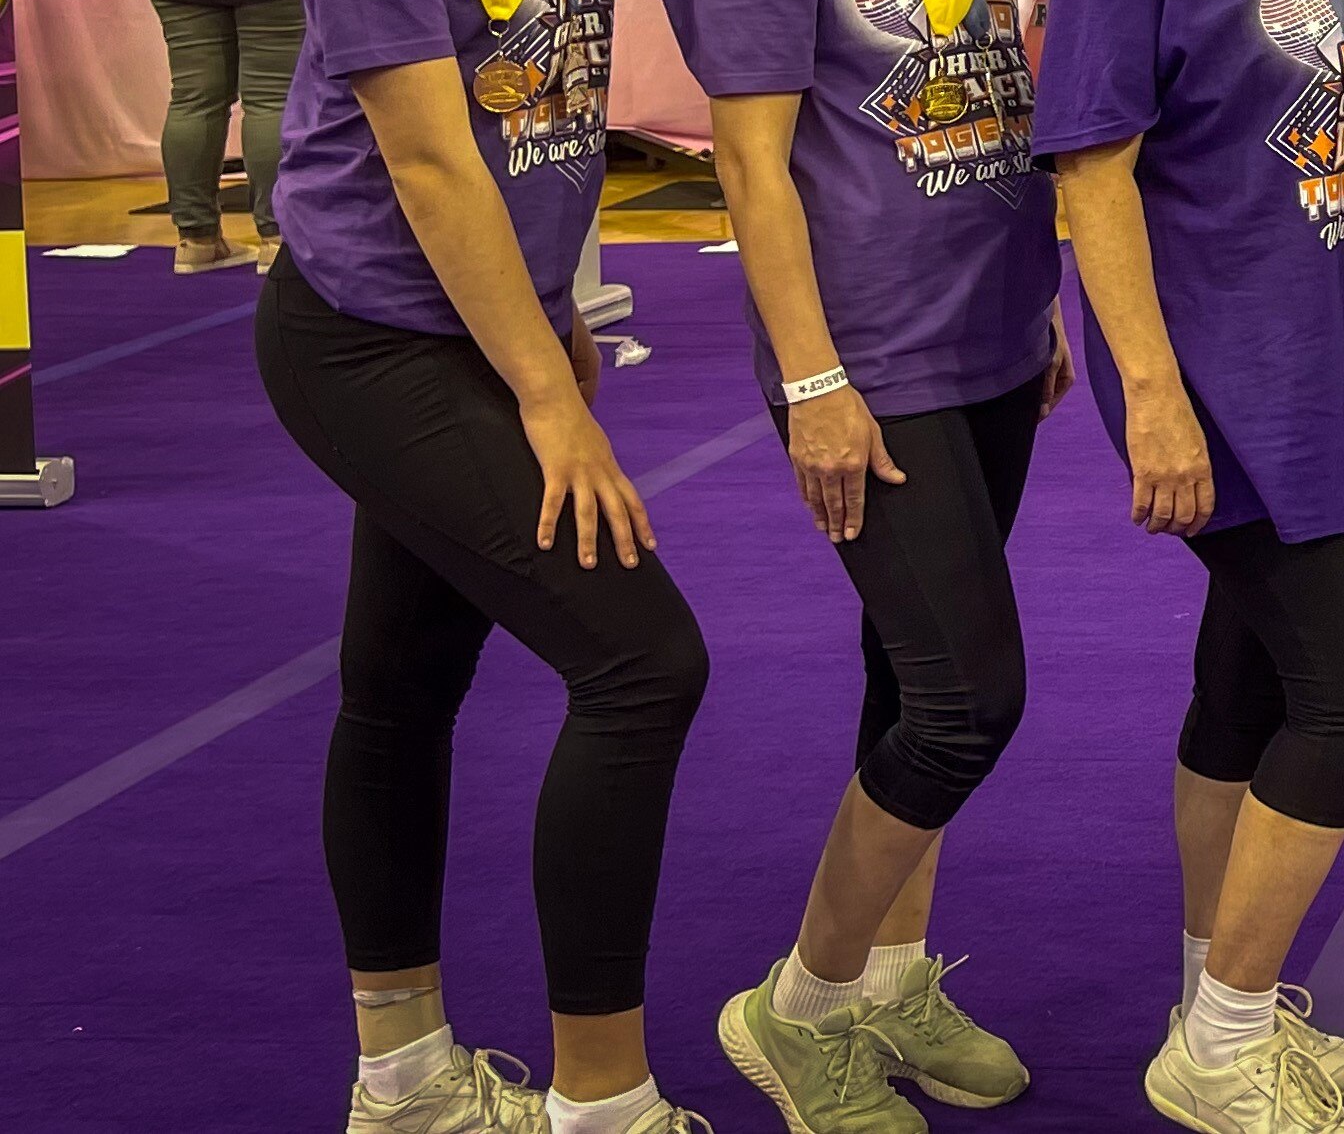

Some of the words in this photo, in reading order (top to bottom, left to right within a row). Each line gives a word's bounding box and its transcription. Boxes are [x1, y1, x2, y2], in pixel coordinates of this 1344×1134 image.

[508, 137, 545, 177] We
[548, 134, 583, 163] are
[916, 163, 970, 197] We
[976, 155, 1009, 182] are
